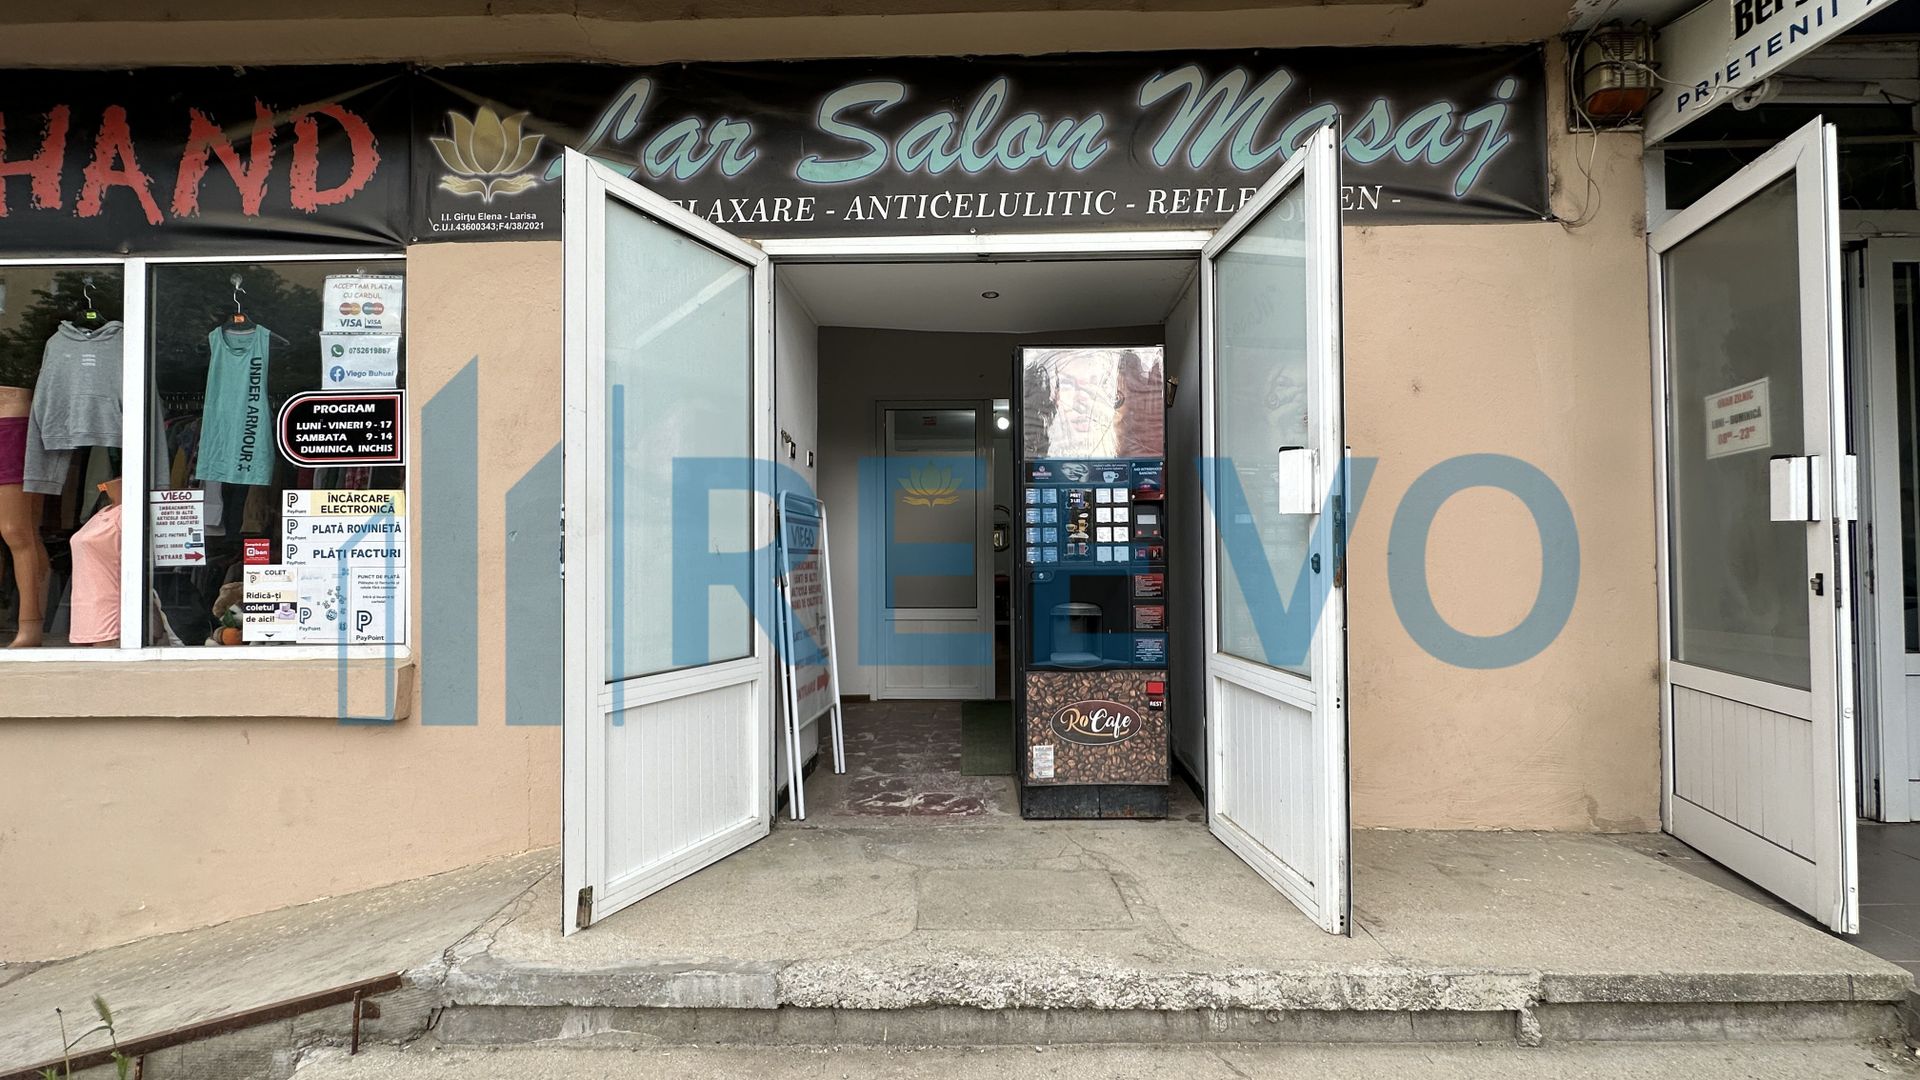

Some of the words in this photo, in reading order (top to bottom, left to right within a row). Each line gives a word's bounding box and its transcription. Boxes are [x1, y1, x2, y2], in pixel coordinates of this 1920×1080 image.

[1677, 0, 1838, 113] PRIETENII
[543, 77, 757, 182] Lar
[796, 77, 1108, 183] Salon
[1138, 64, 1517, 197] Masaj
[0, 97, 381, 225] HAND
[844, 190, 1117, 220] ANTICELULITIC
[478, 212, 502, 221] Elena
[510, 211, 537, 220] Larisa
[340, 318, 362, 328] VISA
[248, 356, 262, 402] UNDER
[313, 403, 375, 414] PROGRAM
[296, 421, 322, 431] LUNI
[328, 421, 364, 430] VINERI
[365, 420, 372, 430] 9
[380, 420, 392, 429] 17
[239, 405, 259, 462] ARMOUR
[295, 433, 347, 443] SAMBATA
[366, 432, 373, 441] 9
[380, 432, 393, 441] 14
[300, 444, 354, 454] DUMINICA
[358, 443, 393, 453] INCHIS
[161, 491, 193, 501] VIEGO
[327, 492, 390, 503] ÎNCĂRCARE
[321, 503, 395, 514] ELECTRONICĂ
[312, 523, 344, 534] PLATĂ
[347, 522, 402, 533] ROVINIETĂ
[351, 548, 401, 559] FACTURI
[245, 603, 274, 612] coletul
[245, 615, 256, 623] de
[258, 615, 275, 623] aici!
[356, 634, 385, 642] PayPoint
